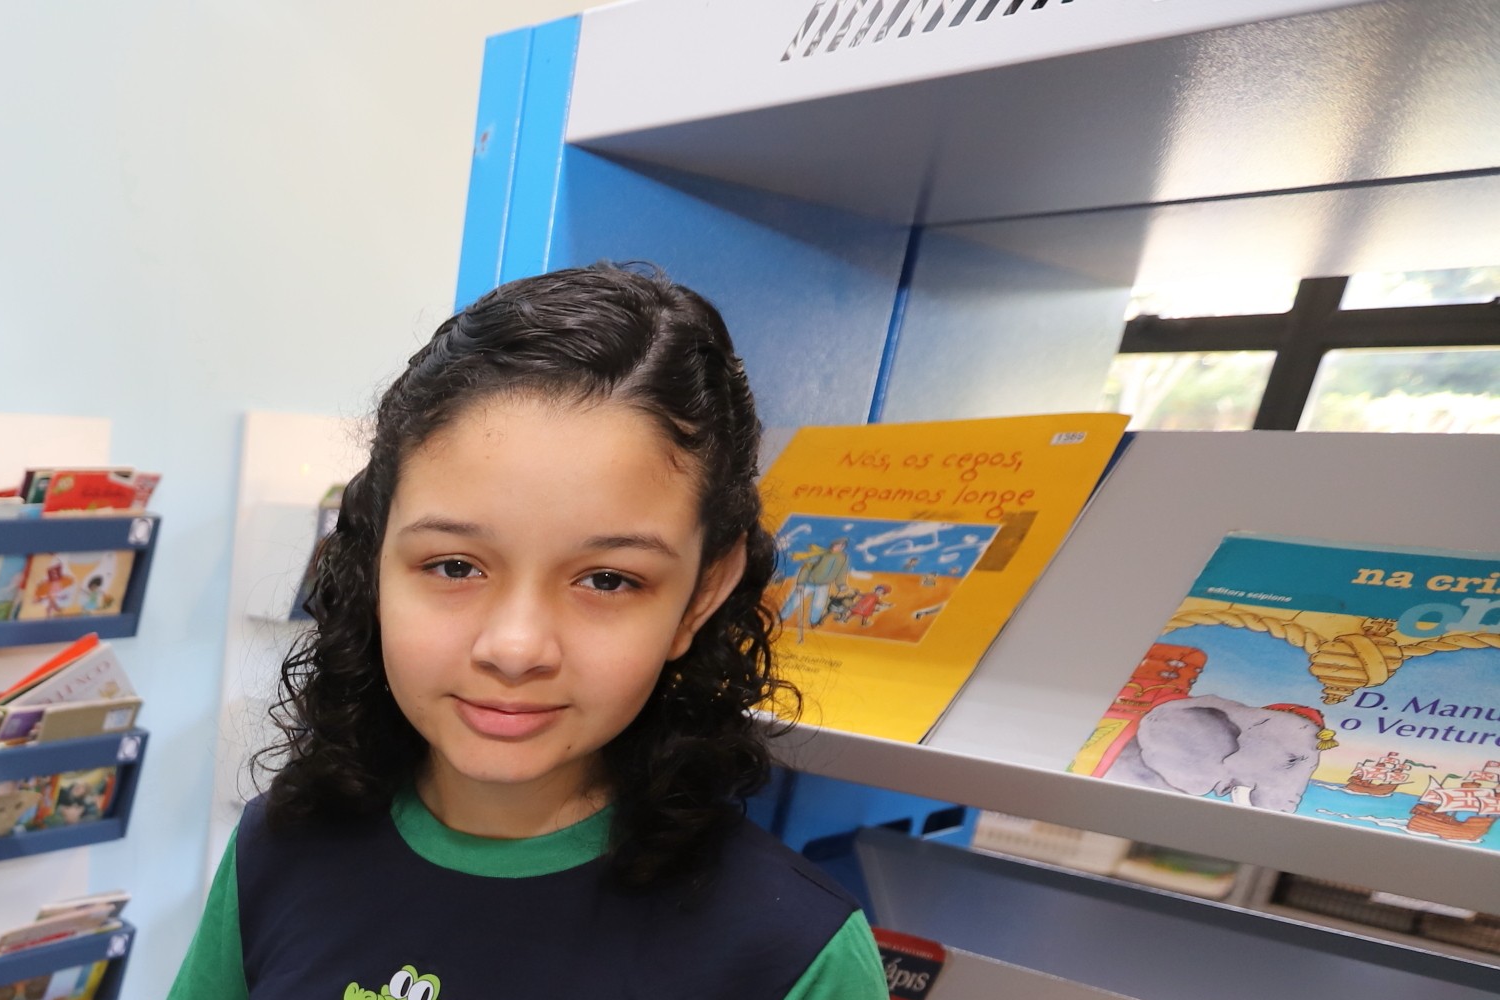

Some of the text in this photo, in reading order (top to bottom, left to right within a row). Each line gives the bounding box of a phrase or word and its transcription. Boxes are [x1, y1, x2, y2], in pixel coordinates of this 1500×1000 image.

[839, 449, 1025, 483] Nós, os cegos,
[792, 482, 1036, 520] enxergamos longe
[1206, 585, 1292, 603] editora scipione
[1351, 567, 1500, 594] na cri
[1354, 691, 1500, 722] D. Manu
[1340, 718, 1362, 731] o
[881, 955, 931, 992] ápis
